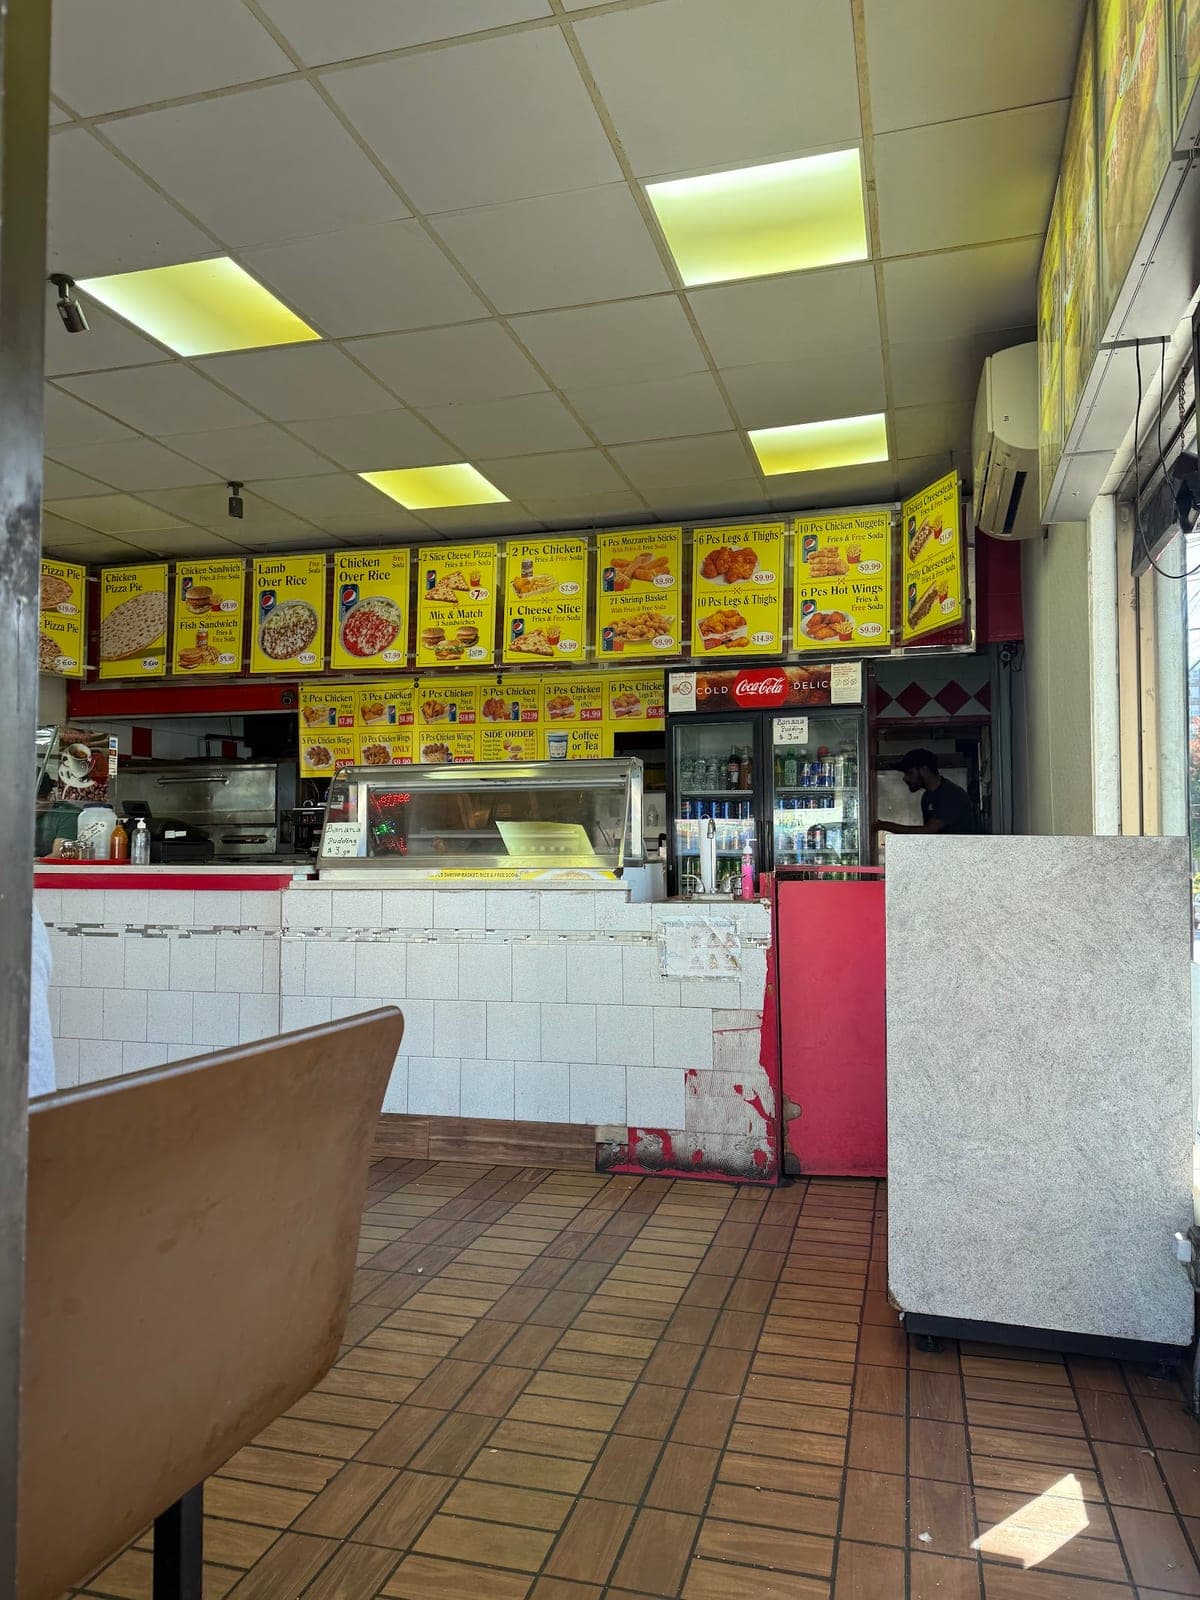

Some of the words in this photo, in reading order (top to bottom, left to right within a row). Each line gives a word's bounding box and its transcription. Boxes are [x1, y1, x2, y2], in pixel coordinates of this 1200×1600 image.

[907, 501, 923, 516] Chicken
[924, 482, 953, 505] Cheesesteak
[799, 524, 809, 533] 10
[810, 524, 823, 532] Pcs
[825, 521, 853, 531] Chicken
[855, 519, 885, 530] Nuggets
[608, 538, 619, 546] Pcs
[622, 535, 656, 545] Mozzarella
[658, 533, 676, 541] Sticks
[699, 535, 704, 545] 6
[706, 534, 720, 544] Pcs
[722, 533, 740, 545] Legs
[743, 533, 749, 542] &
[752, 531, 778, 543] Thighs
[512, 548, 518, 556] 2
[522, 546, 539, 556] Pcs
[545, 544, 582, 554] Chicken
[429, 553, 445, 561] Slice
[448, 552, 471, 560] Cheese
[474, 550, 491, 558] Pizza
[340, 558, 380, 568] Chicken
[922, 552, 955, 574] Cheesesteak
[42, 564, 63, 576] Pizza
[67, 569, 80, 579] Pie
[181, 567, 207, 575] Chicken
[209, 565, 240, 573] Sandwich
[259, 564, 285, 574] Lamb
[106, 574, 136, 582] Chicken
[340, 572, 364, 582] Over
[368, 570, 390, 580] Rice
[258, 577, 282, 587] Over
[286, 576, 307, 586] Rice
[106, 585, 127, 593] Pizza
[130, 583, 143, 591] Pie
[801, 589, 807, 597] 6
[811, 587, 828, 596] Pcs
[831, 586, 848, 595] Hot
[852, 583, 883, 594] Wings
[610, 597, 618, 605] 21
[620, 596, 643, 606] Shrimp
[646, 593, 668, 603] Basket
[698, 598, 706, 608] 10
[708, 598, 722, 607] Pcs
[724, 597, 741, 608] Legs
[744, 596, 749, 605] &
[752, 594, 777, 606] Thighs
[430, 611, 444, 620] Mix
[448, 611, 453, 619] &
[457, 609, 482, 619] Match
[518, 606, 552, 616] Cheese
[556, 604, 580, 614] Slice
[44, 620, 64, 632] Pizza
[67, 623, 79, 633] Pie
[200, 621, 238, 629] Sandwich
[554, 686, 568, 694] Pcs
[570, 686, 600, 694] Chicken
[619, 684, 633, 692] Pcs
[696, 687, 728, 695] COLD
[735, 676, 785, 695] Coca-Cola
[384, 692, 412, 700] Chicken
[490, 688, 504, 696] Pcs
[325, 694, 352, 702] Chicken
[781, 725, 804, 734] Pudding
[572, 731, 599, 739] Coffee
[318, 736, 336, 744] Chicken
[337, 736, 352, 745] Wings
[584, 741, 598, 749] Tea
[327, 824, 361, 833] Banana
[328, 838, 358, 846] Pudding
